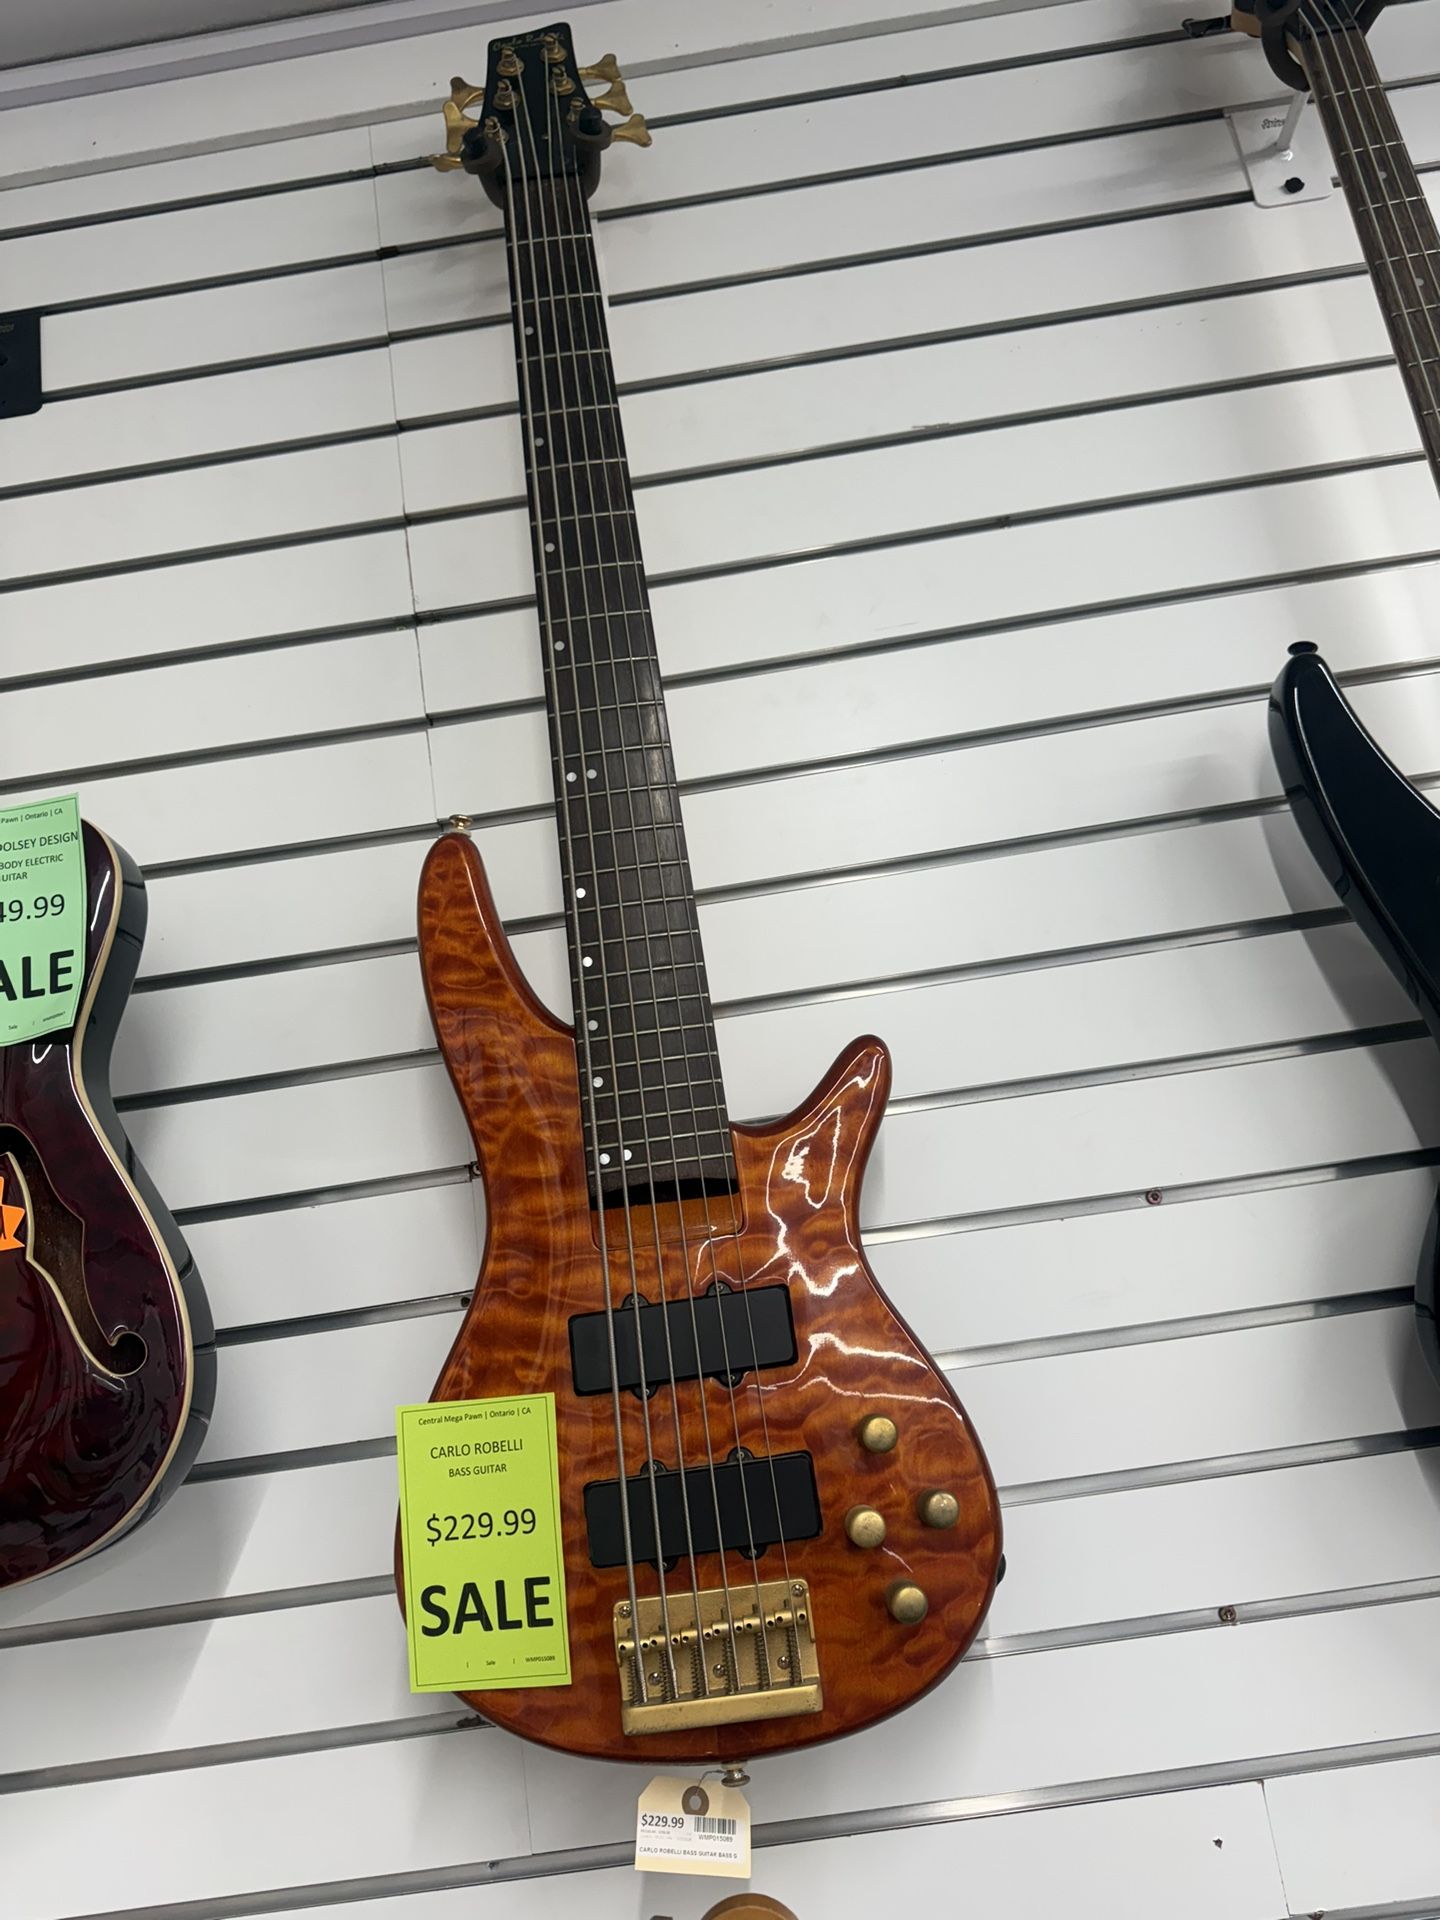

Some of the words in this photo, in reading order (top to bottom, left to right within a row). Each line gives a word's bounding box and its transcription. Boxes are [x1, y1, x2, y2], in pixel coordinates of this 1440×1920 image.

[0, 816, 19, 824] Pawn
[25, 811, 49, 820] Ontario
[0, 838, 37, 852] OLSEY
[39, 831, 79, 847] DESIGN
[25, 853, 64, 867] ELECTRIC
[0, 871, 28, 882] UITAR
[418, 1415, 443, 1426] Central
[444, 1414, 463, 1424] Mega
[464, 1412, 483, 1421] Pawn
[489, 1408, 515, 1418] Ontario
[521, 1406, 532, 1415] CA
[430, 1443, 471, 1459] CARLO
[474, 1438, 523, 1455] ROBELLI
[448, 1466, 472, 1478] BASS
[473, 1463, 508, 1476] GUITAR
[426, 1508, 536, 1547] $229.99
[420, 1576, 554, 1638] SALE
[641, 1813, 684, 1828] $229.99
[639, 1846, 658, 1854] CARLO
[659, 1847, 682, 1855] ROBELLI
